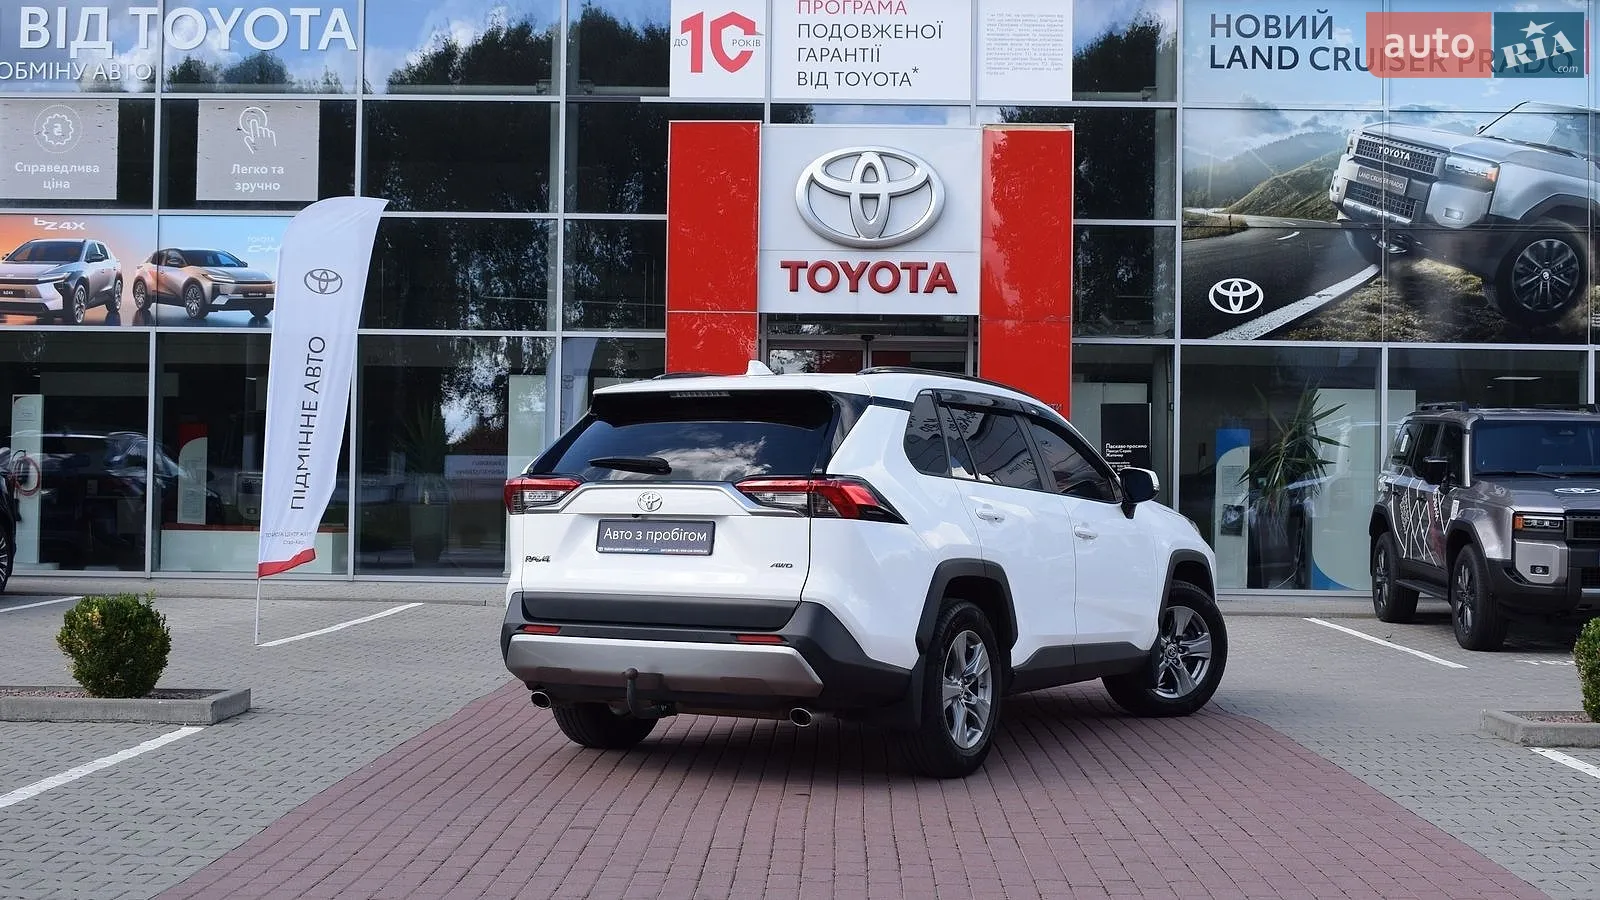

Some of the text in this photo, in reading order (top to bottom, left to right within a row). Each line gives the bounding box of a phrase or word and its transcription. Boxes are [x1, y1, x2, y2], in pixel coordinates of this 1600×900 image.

[798, 0, 908, 15] ПРОГРАМА
[20, 6, 358, 59] ВІД TOYOTA
[797, 20, 944, 42] ПОДОВЖЕНОЇ
[1210, 9, 1334, 40] НОВИЙ
[674, 38, 689, 47] ДО
[732, 39, 761, 47] РОКІВ
[797, 43, 882, 63] ГАРАНТІЇ
[1210, 45, 1300, 70] LAND
[92, 62, 152, 81] АВТО
[797, 71, 829, 90] ВІД
[1378, 146, 1411, 161] TOYOTA
[15, 162, 100, 174] Справедлива
[231, 163, 284, 174] Легко та
[43, 178, 71, 189] ціна
[234, 182, 281, 192] зручно
[780, 260, 958, 294] TOYOTA
[303, 336, 326, 394] АВТО
[290, 400, 318, 509] ПІДМІННЕ
[603, 527, 707, 544] Авто з пробігом
